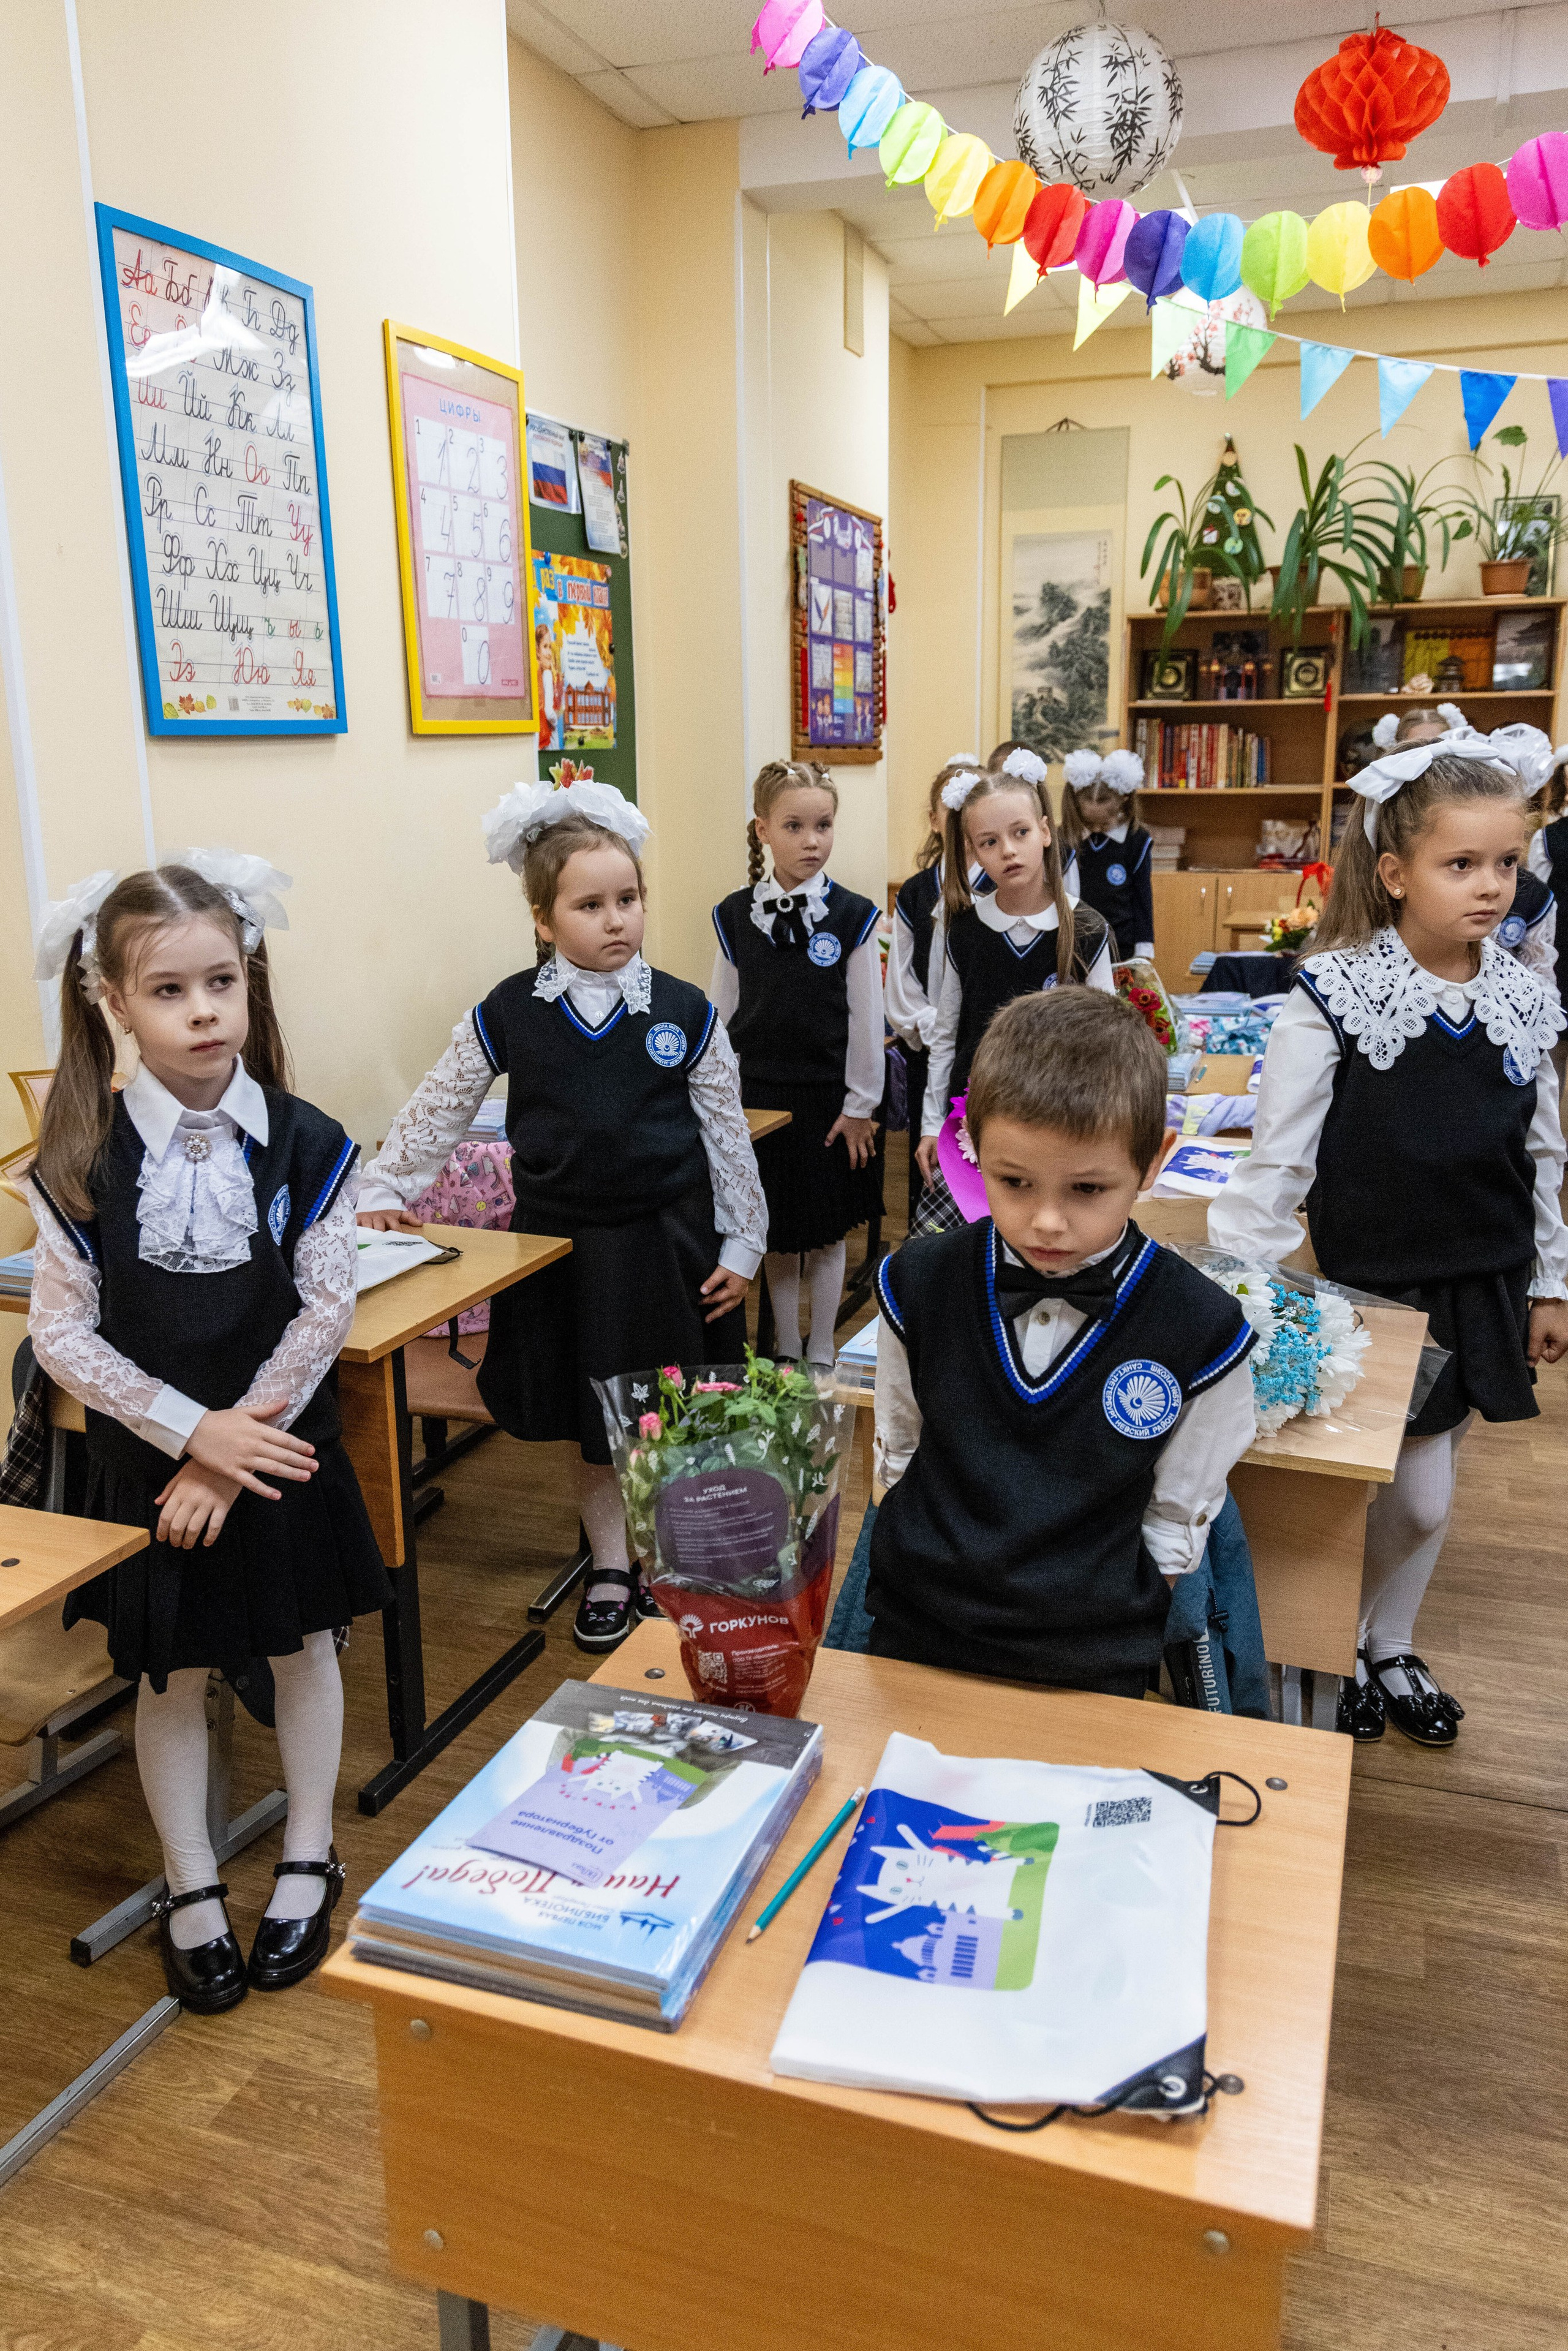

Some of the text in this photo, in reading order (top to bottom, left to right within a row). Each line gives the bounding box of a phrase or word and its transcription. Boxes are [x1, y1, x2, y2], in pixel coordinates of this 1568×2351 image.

[121, 249, 158, 296] Аа
[164, 260, 198, 306] Бб
[241, 289, 261, 331] Гг
[270, 301, 300, 355] Дд
[272, 351, 296, 406] Зз
[178, 370, 213, 421] Йй
[227, 390, 256, 431] Кк
[266, 401, 294, 442] Лл
[439, 397, 481, 424] ЦИФРЫ
[415, 418, 484, 453] 1 2 3
[141, 422, 311, 495] Мм Нн Оо Пп
[437, 439, 508, 499] 1 2 3
[145, 477, 314, 556] Рр Сс Тт Уу
[420, 487, 488, 517] 4 5 6
[440, 505, 511, 562] 4 5 6
[162, 534, 312, 594] Фф Хх Цц Чч
[425, 557, 492, 582] 7 8 9
[157, 588, 203, 630] Шш
[209, 594, 254, 641] Щщ
[443, 572, 514, 624] 7 8 9
[462, 627, 467, 642] 0
[170, 642, 316, 686] Ээ Юю Яя
[478, 640, 489, 684] 0
[1106, 1363, 1143, 1419] САНКТ-ПЕТЕРБУРГ
[1150, 1365, 1174, 1386] ШКОЛА
[1115, 1413, 1175, 1436] НЕВСКИЙ РАЙОН
[696, 1487, 748, 1503] РАСТЕНИЕМ
[702, 1484, 726, 1495] УХОД
[709, 1615, 790, 1634] ГОРКУНОВ
[511, 1819, 603, 1854] Поздравление
[518, 1811, 614, 1846] от Губернатора
[401, 1860, 558, 1895] Победа!
[523, 1896, 611, 1923] БИБЛИОТЕКА
[538, 1911, 578, 1926] ПЕРВАЯ
